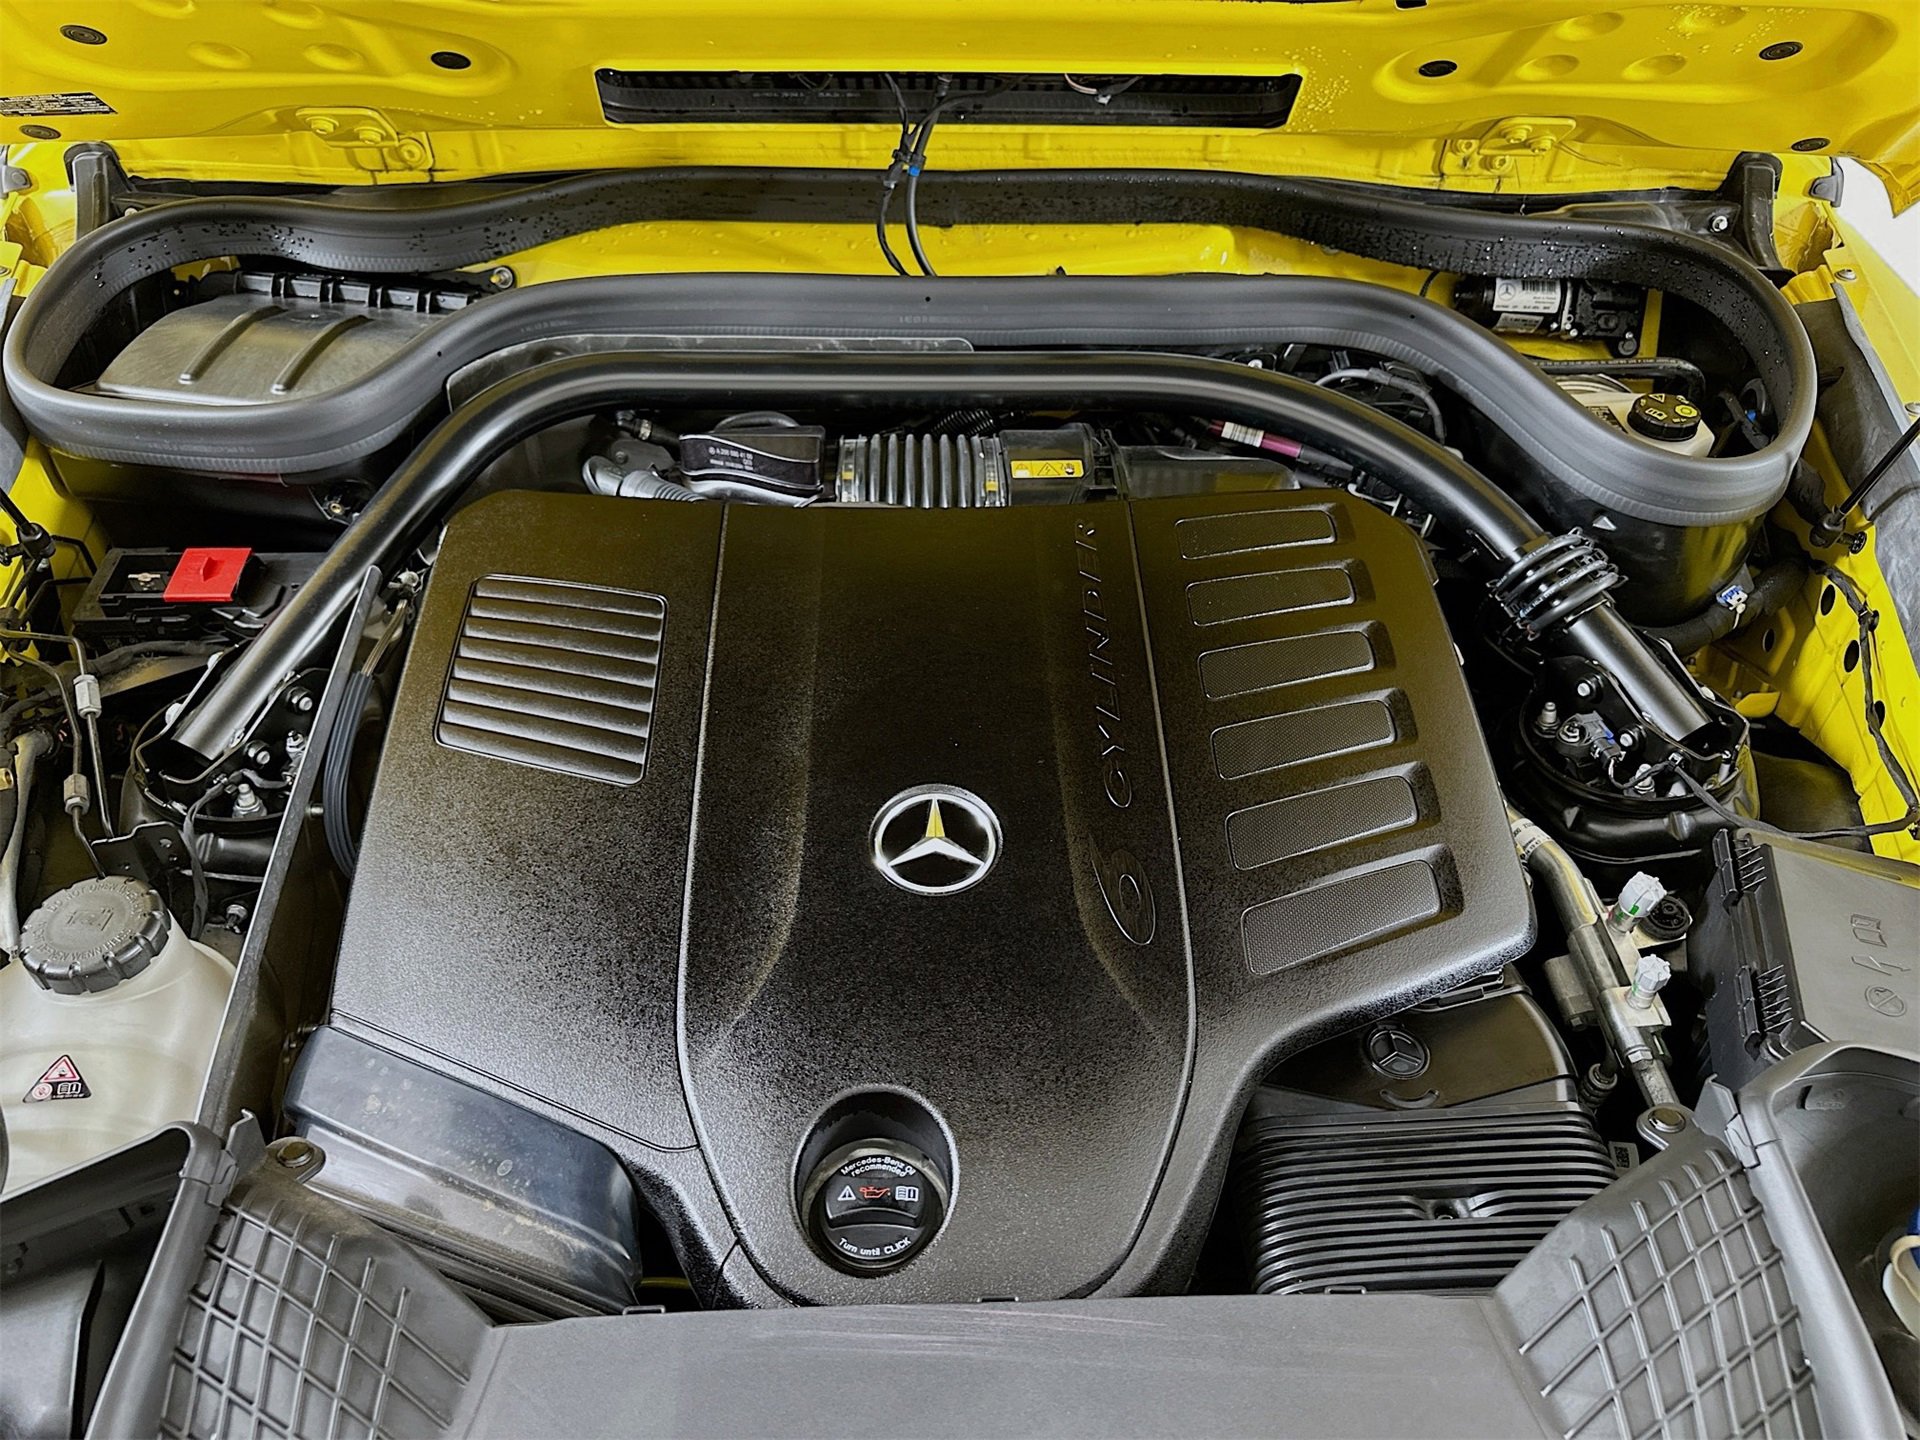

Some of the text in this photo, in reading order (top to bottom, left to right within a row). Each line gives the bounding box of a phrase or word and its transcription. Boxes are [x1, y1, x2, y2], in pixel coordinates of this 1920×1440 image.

[1075, 521, 1157, 946] 6 CYLINDER
[840, 1157, 917, 1176] Mercedes-Benz Oil
[850, 1163, 908, 1177] recommended
[839, 1237, 911, 1256] Turn until CLICK
